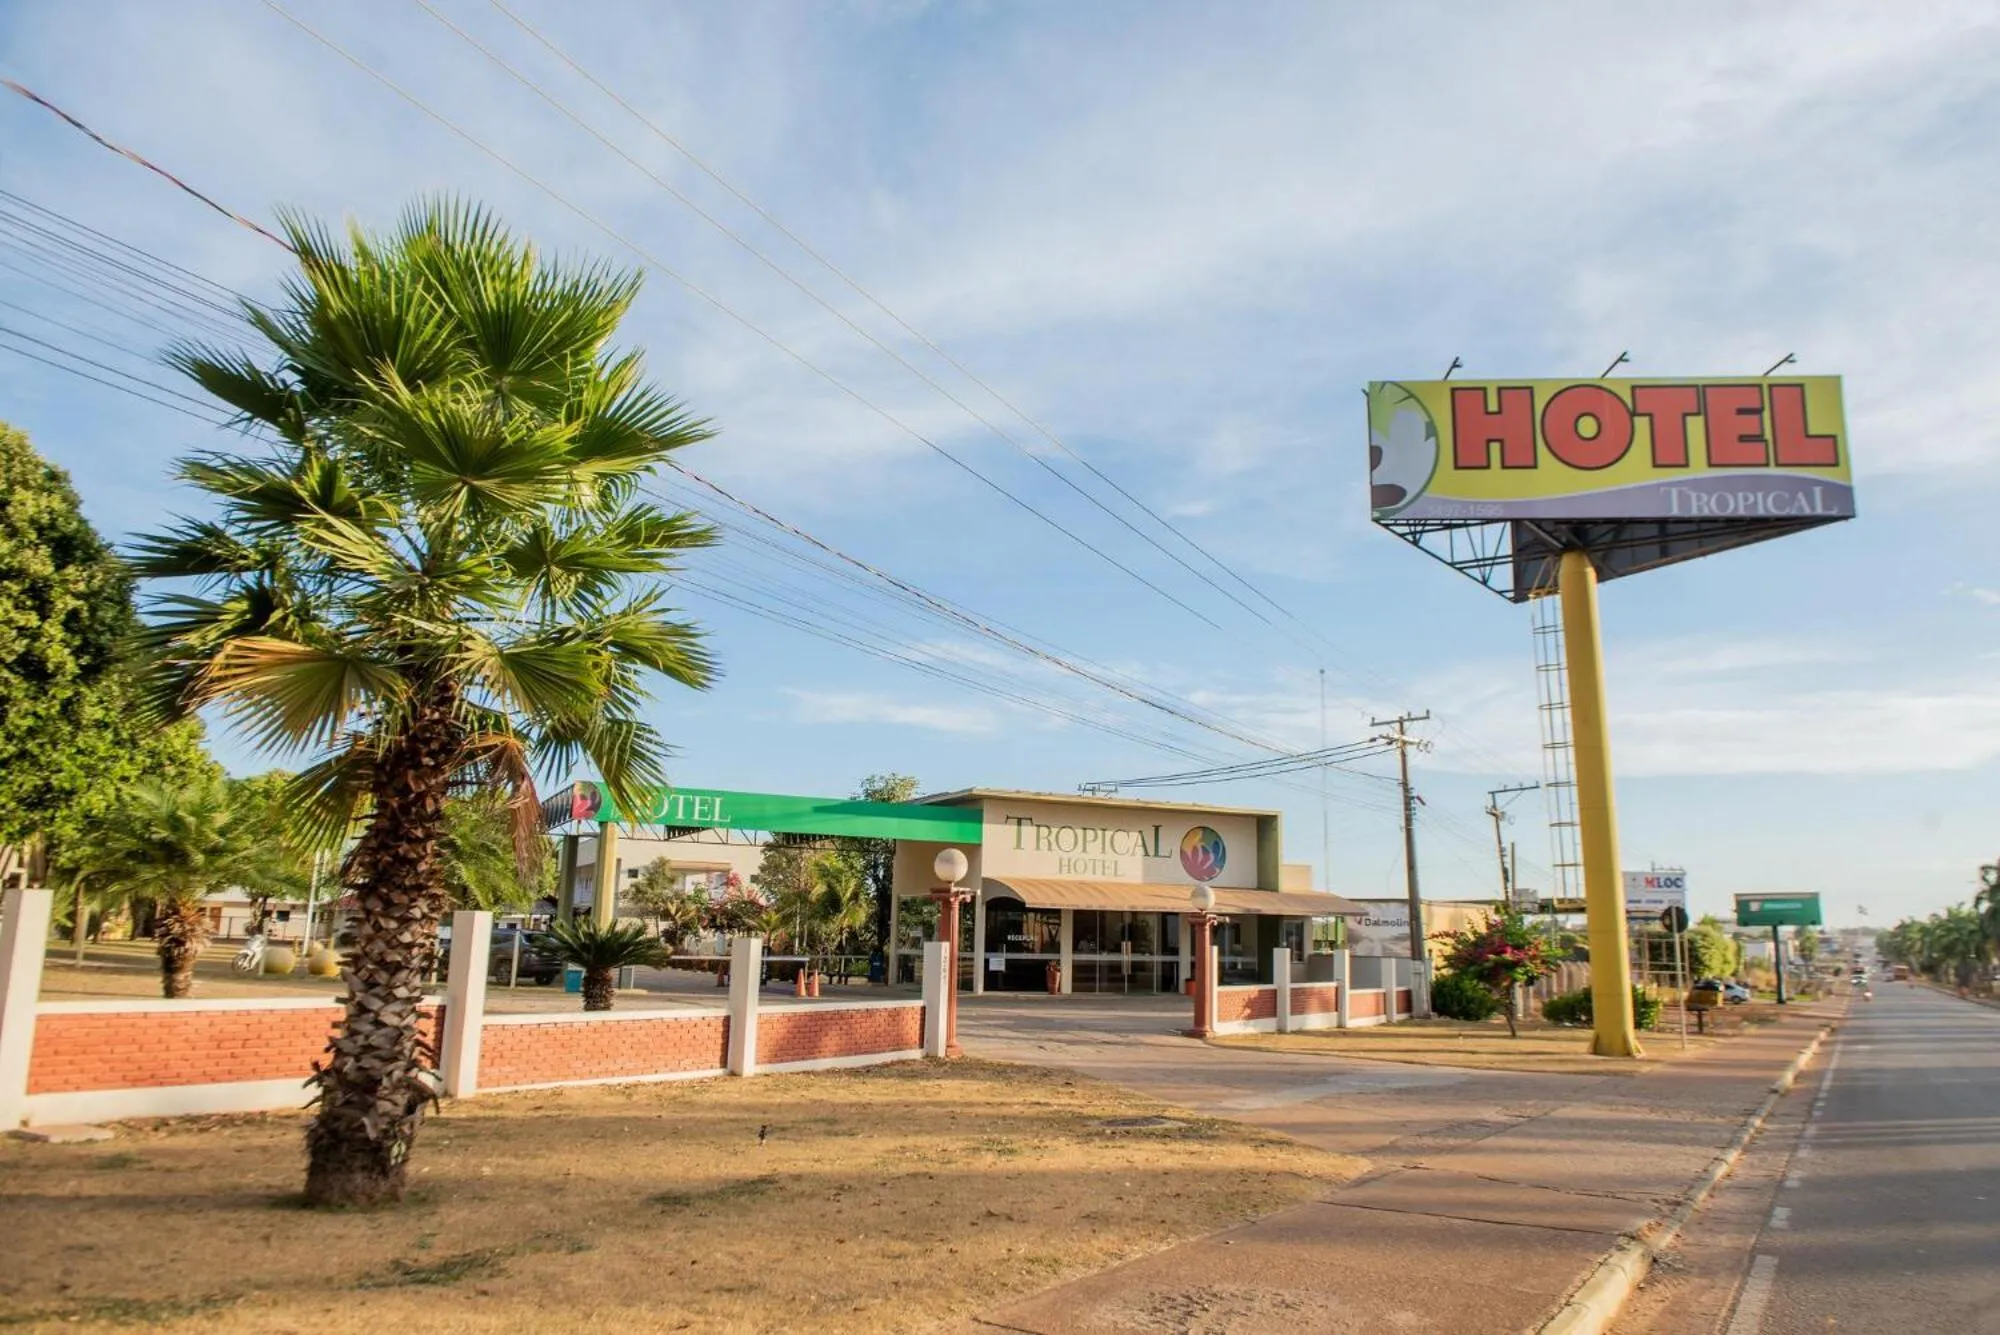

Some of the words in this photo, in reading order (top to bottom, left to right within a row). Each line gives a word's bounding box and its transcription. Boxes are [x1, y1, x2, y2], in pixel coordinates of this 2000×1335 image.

[1451, 384, 1839, 470] HOTEL
[1660, 486, 1839, 516] TROPICAL
[1005, 814, 1172, 859] TROPICAL
[1057, 857, 1125, 877] HOTEL
